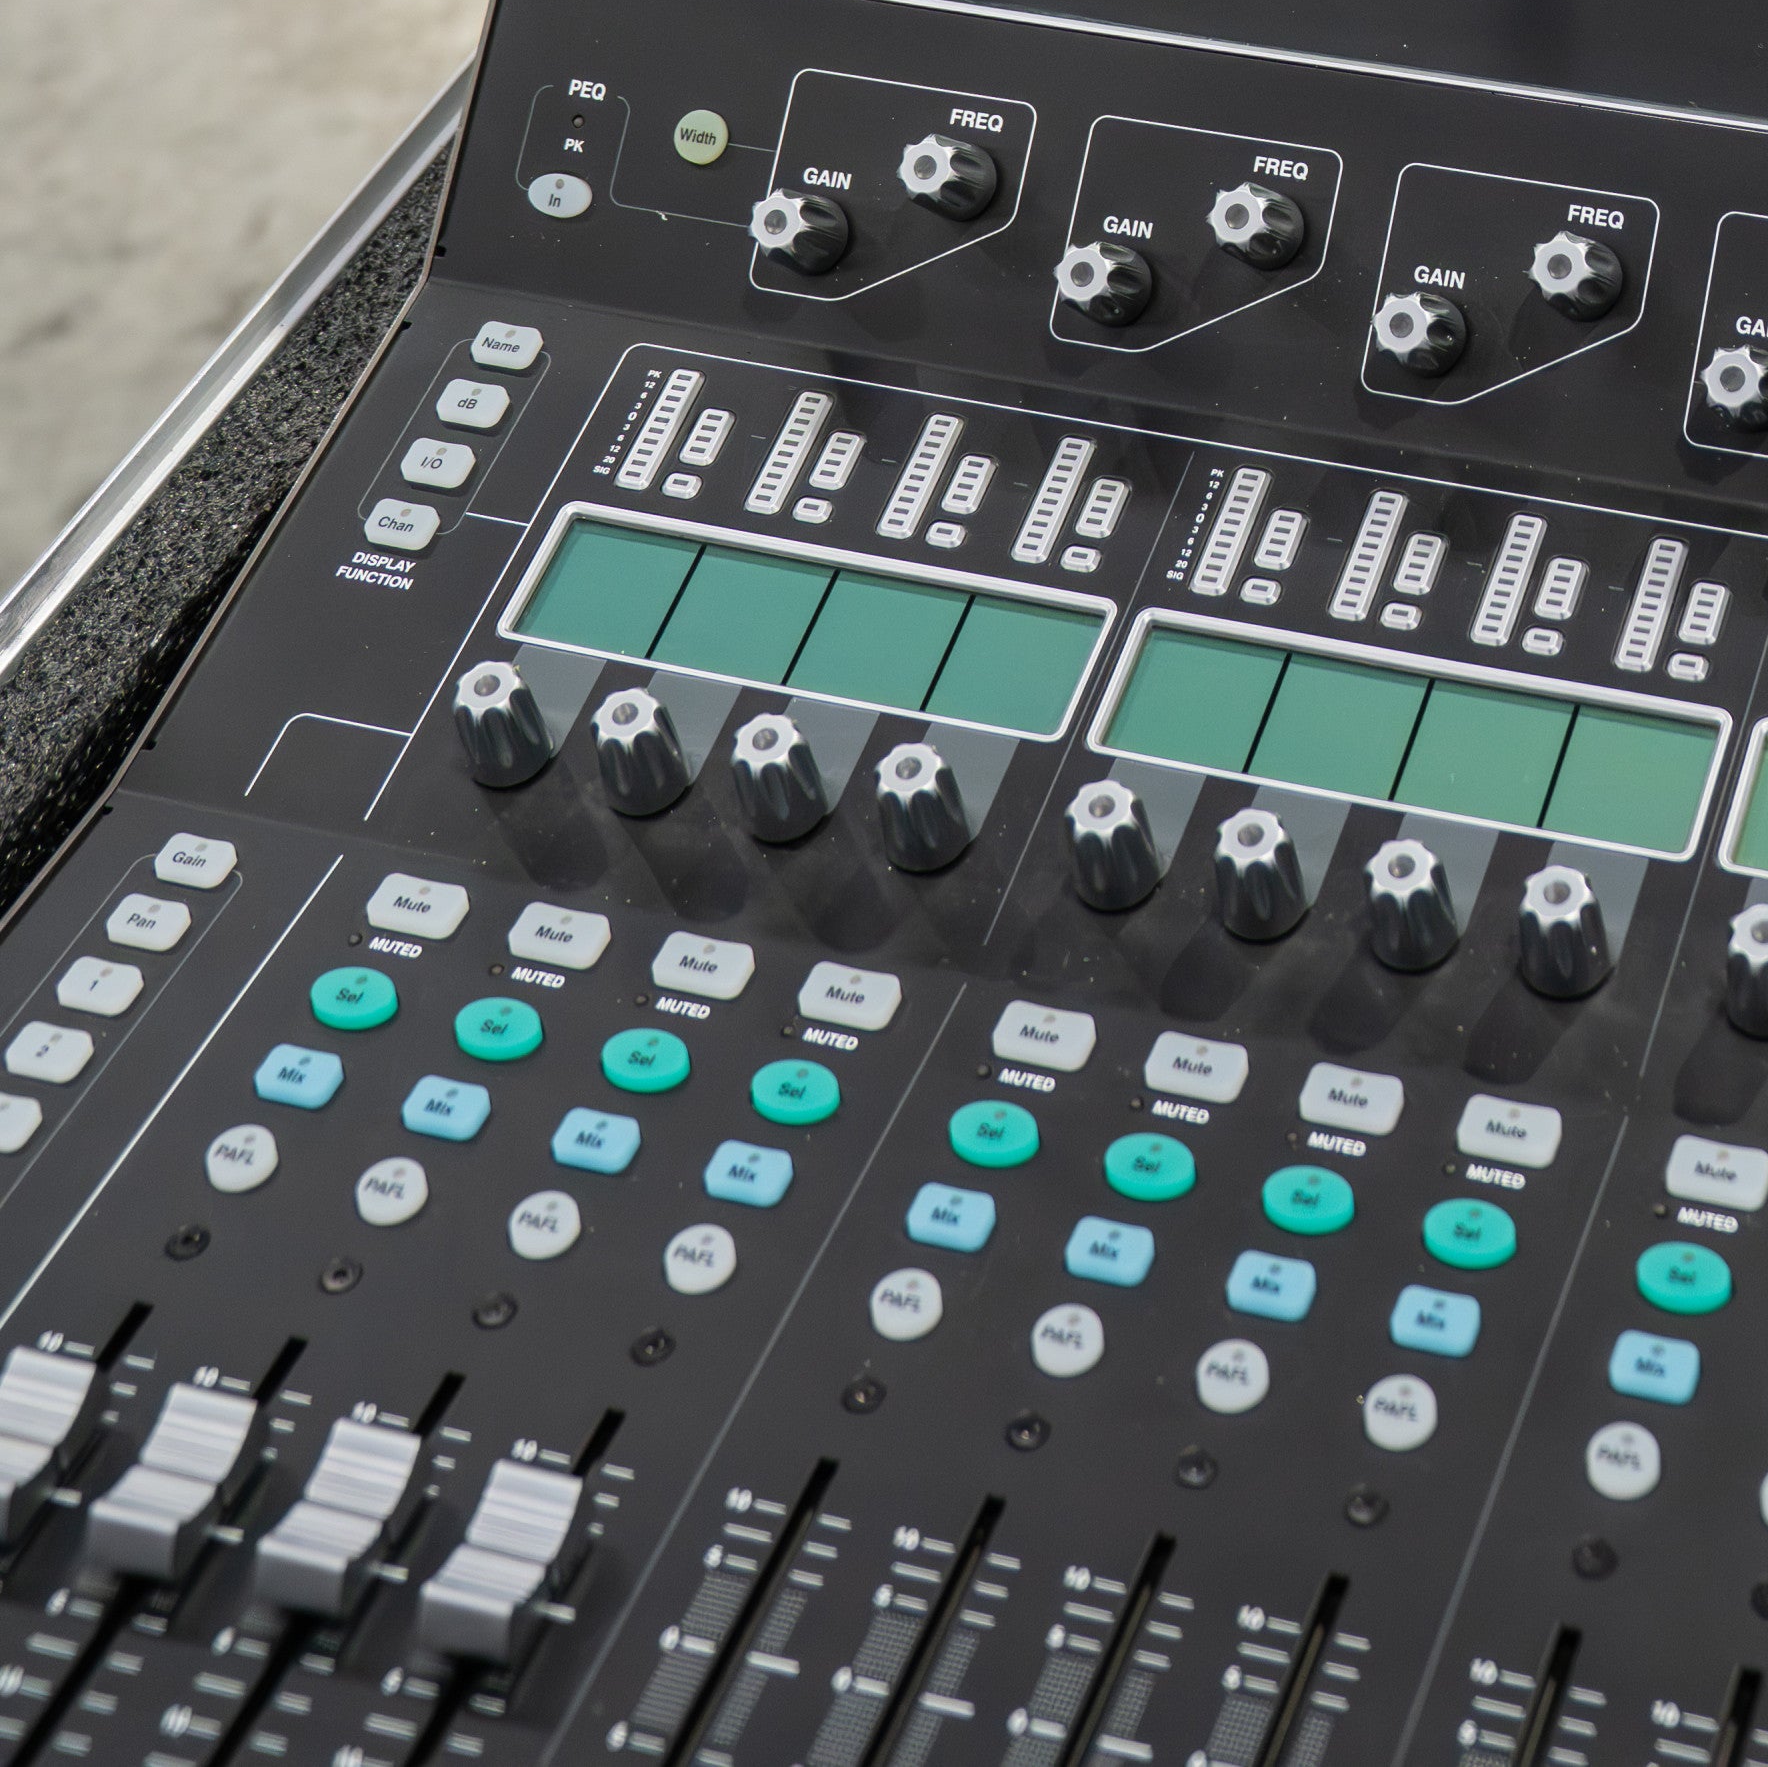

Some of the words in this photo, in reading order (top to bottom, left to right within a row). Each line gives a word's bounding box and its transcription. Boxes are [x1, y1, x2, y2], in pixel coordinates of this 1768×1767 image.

[569, 79, 606, 100] PEQ
[950, 109, 1003, 132] FREQ
[564, 138, 584, 152] PK
[681, 128, 716, 145] Width
[1254, 156, 1308, 180] FREQ
[804, 168, 851, 189] GAIN
[549, 194, 561, 207] In
[1568, 205, 1624, 229] FREQ
[1104, 216, 1153, 238] GAIN
[1415, 266, 1465, 289] GAIN
[482, 337, 520, 352] Name
[648, 370, 661, 378] PK
[458, 399, 477, 409] dB
[628, 412, 637, 420] 0
[421, 457, 442, 469] I/O
[593, 466, 610, 474] SIG
[379, 516, 413, 531] Chan
[352, 551, 416, 573] DISPLAY
[336, 565, 414, 590] FUNCTION
[173, 852, 206, 866] Gain
[394, 896, 430, 912] Mute
[127, 913, 156, 928] Pan
[536, 926, 572, 942] Mute
[369, 937, 422, 957] MUTED
[680, 956, 717, 972] Mute
[91, 980, 98, 990] 1
[512, 967, 565, 987] MUTED
[335, 987, 363, 1006] Sel
[826, 986, 864, 1003] Mute
[656, 997, 710, 1019] MUTED
[480, 1018, 507, 1037] Sel
[1020, 1025, 1059, 1042] Mute
[803, 1028, 858, 1050] MUTED
[36, 1045, 49, 1057] 2
[626, 1049, 655, 1069] Sel
[277, 1065, 305, 1085] Mix
[1173, 1057, 1212, 1074] Mute
[999, 1068, 1055, 1091] MUTED
[778, 1082, 805, 1101] Sel
[1328, 1089, 1367, 1107] Mute
[424, 1097, 455, 1118] Mix
[1153, 1100, 1209, 1123] MUTED
[1486, 1121, 1526, 1138] Mute
[573, 1130, 605, 1151] Mix
[1308, 1132, 1366, 1156] MUTED
[726, 1163, 758, 1183] Mix
[1467, 1164, 1525, 1189] MUTED
[1695, 1162, 1736, 1181] Mute
[1678, 1207, 1738, 1232] MUTED
